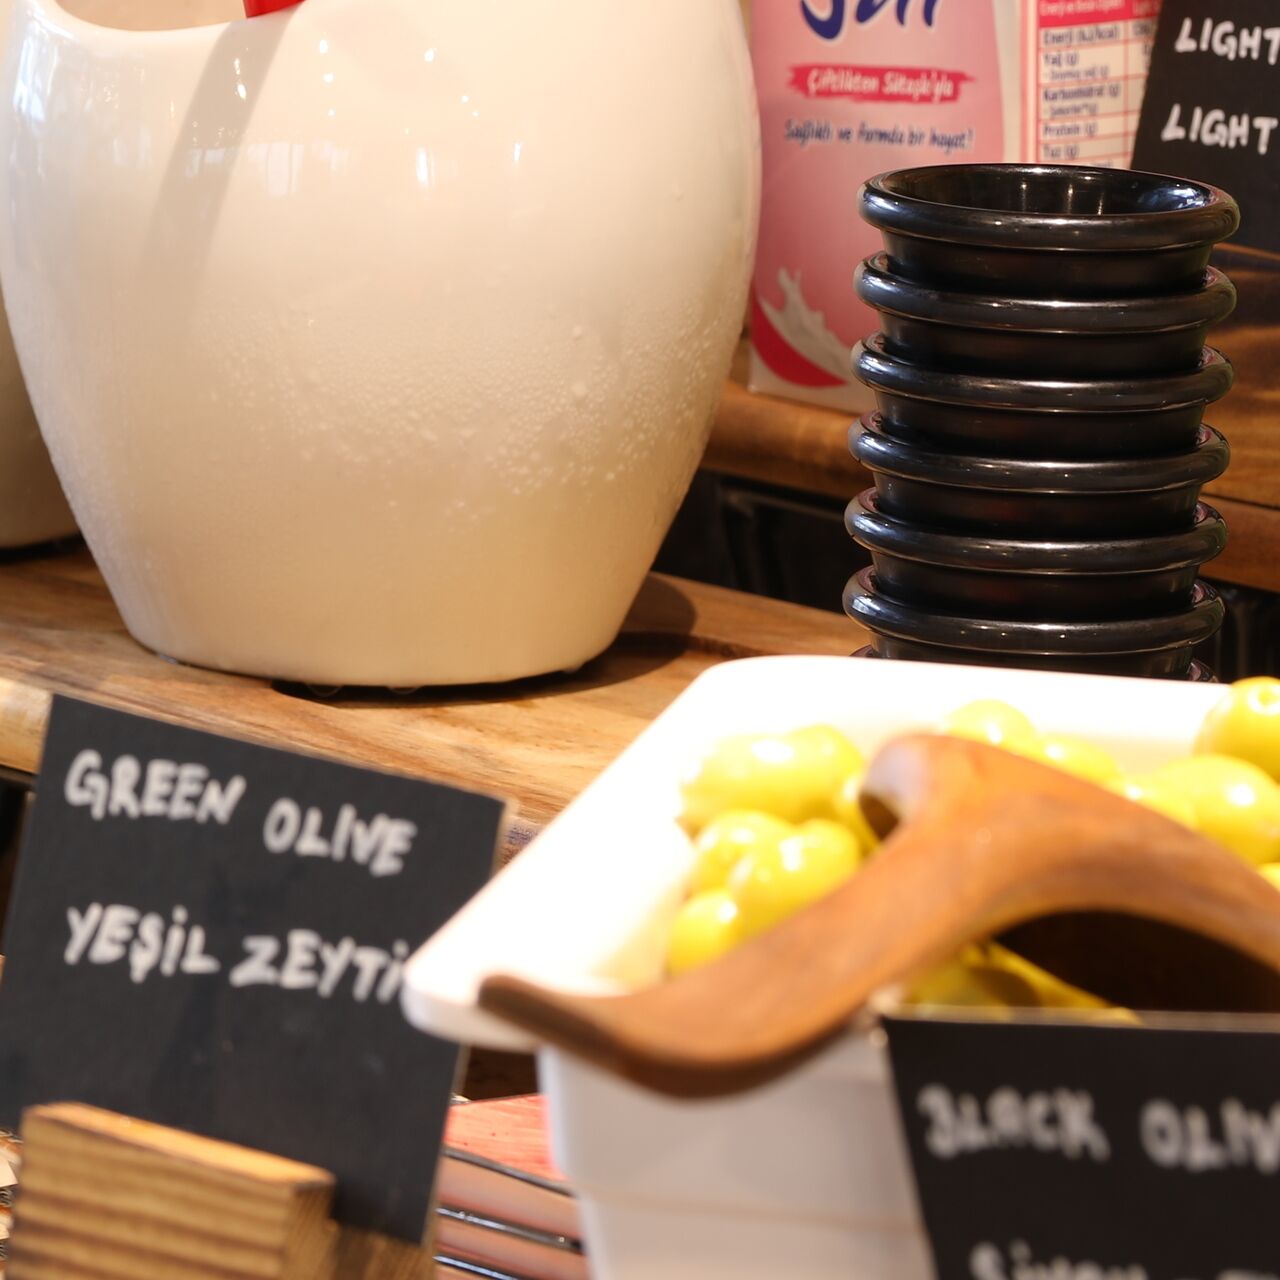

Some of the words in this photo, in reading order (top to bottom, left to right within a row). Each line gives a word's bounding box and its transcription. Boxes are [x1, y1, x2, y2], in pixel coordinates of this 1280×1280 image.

[1174, 17, 1280, 66] LIGHT
[1161, 102, 1279, 156] LIGHT
[64, 749, 247, 823] GREEN
[263, 797, 418, 877] OLIVE
[228, 927, 410, 1004] ZEYTİ
